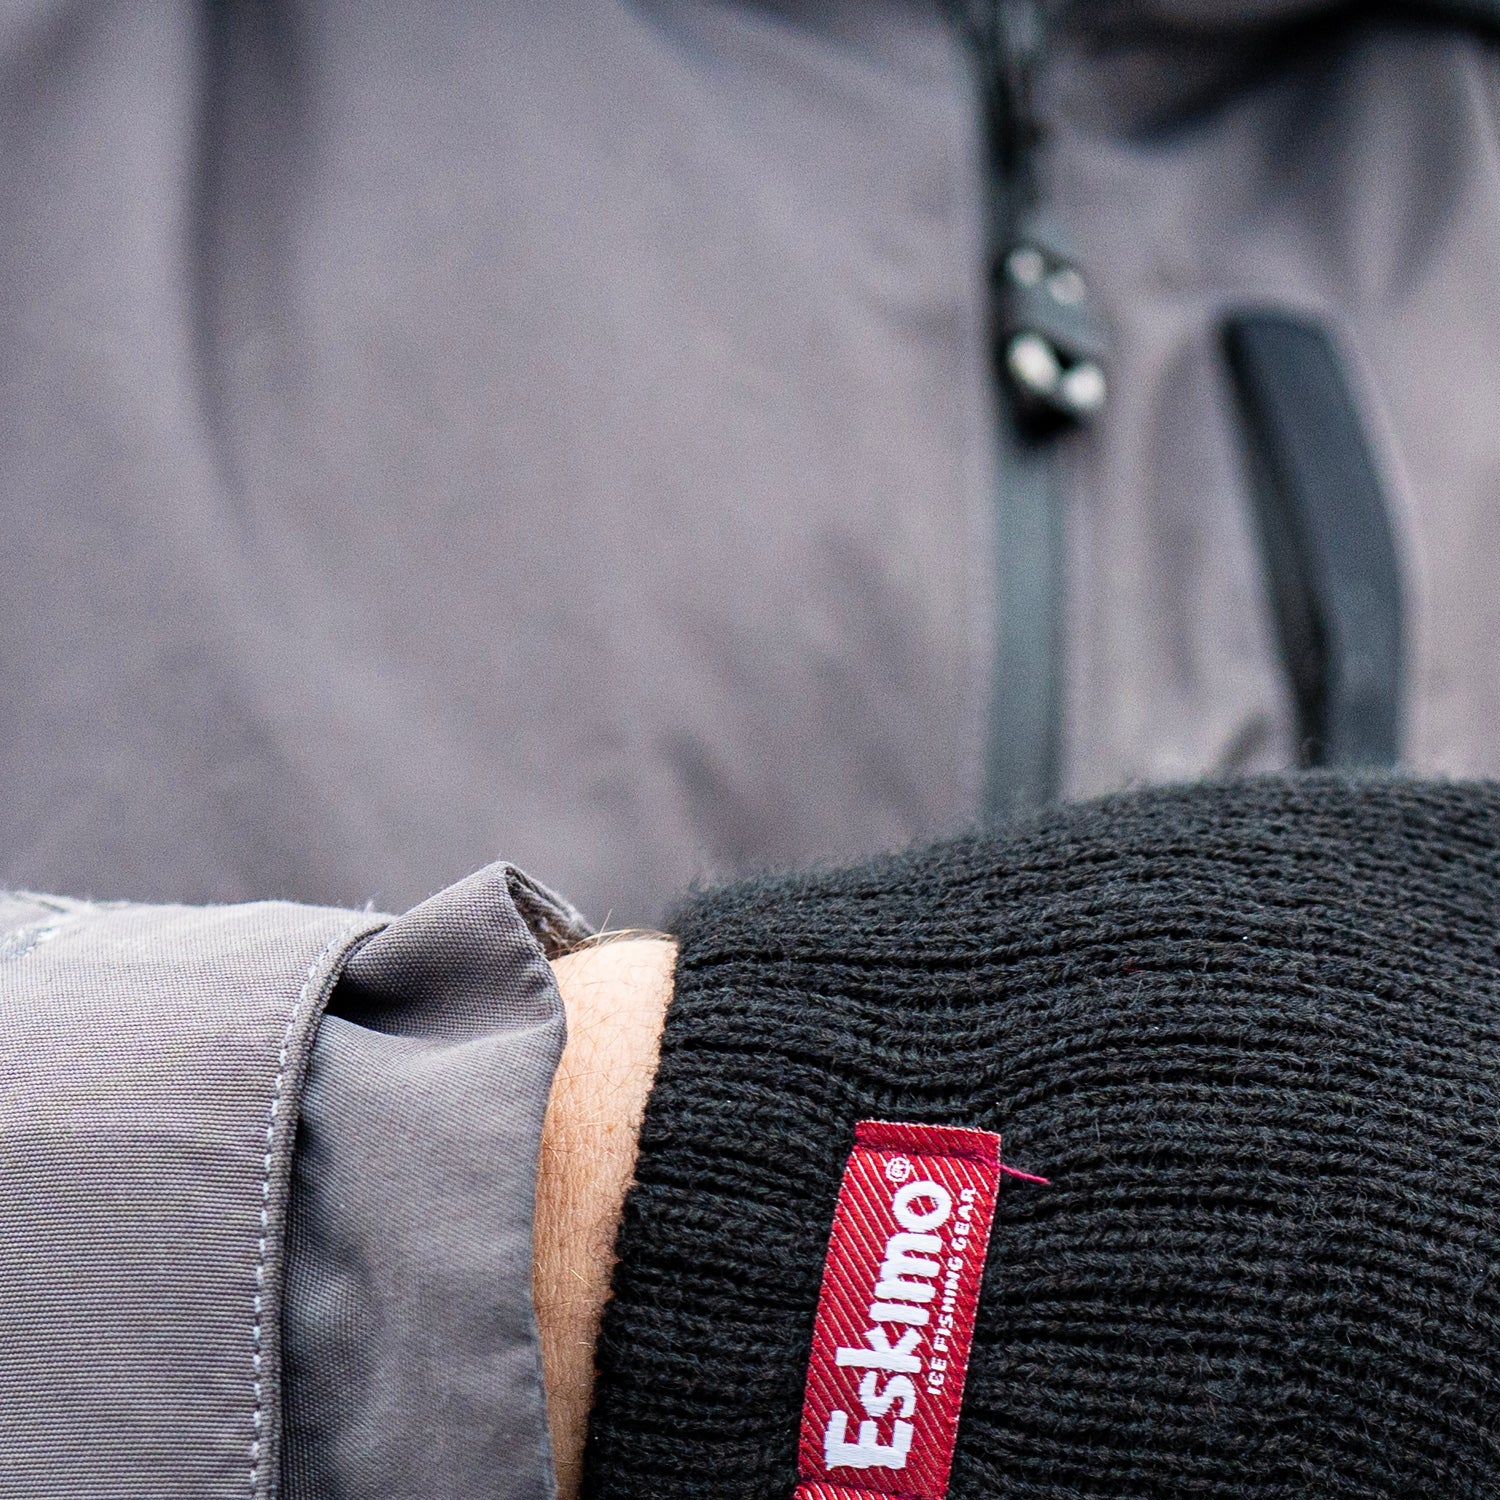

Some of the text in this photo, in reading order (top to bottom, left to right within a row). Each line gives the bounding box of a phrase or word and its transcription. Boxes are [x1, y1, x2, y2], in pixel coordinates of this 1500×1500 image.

[927, 1187, 977, 1396] ICE FISHING GEAR
